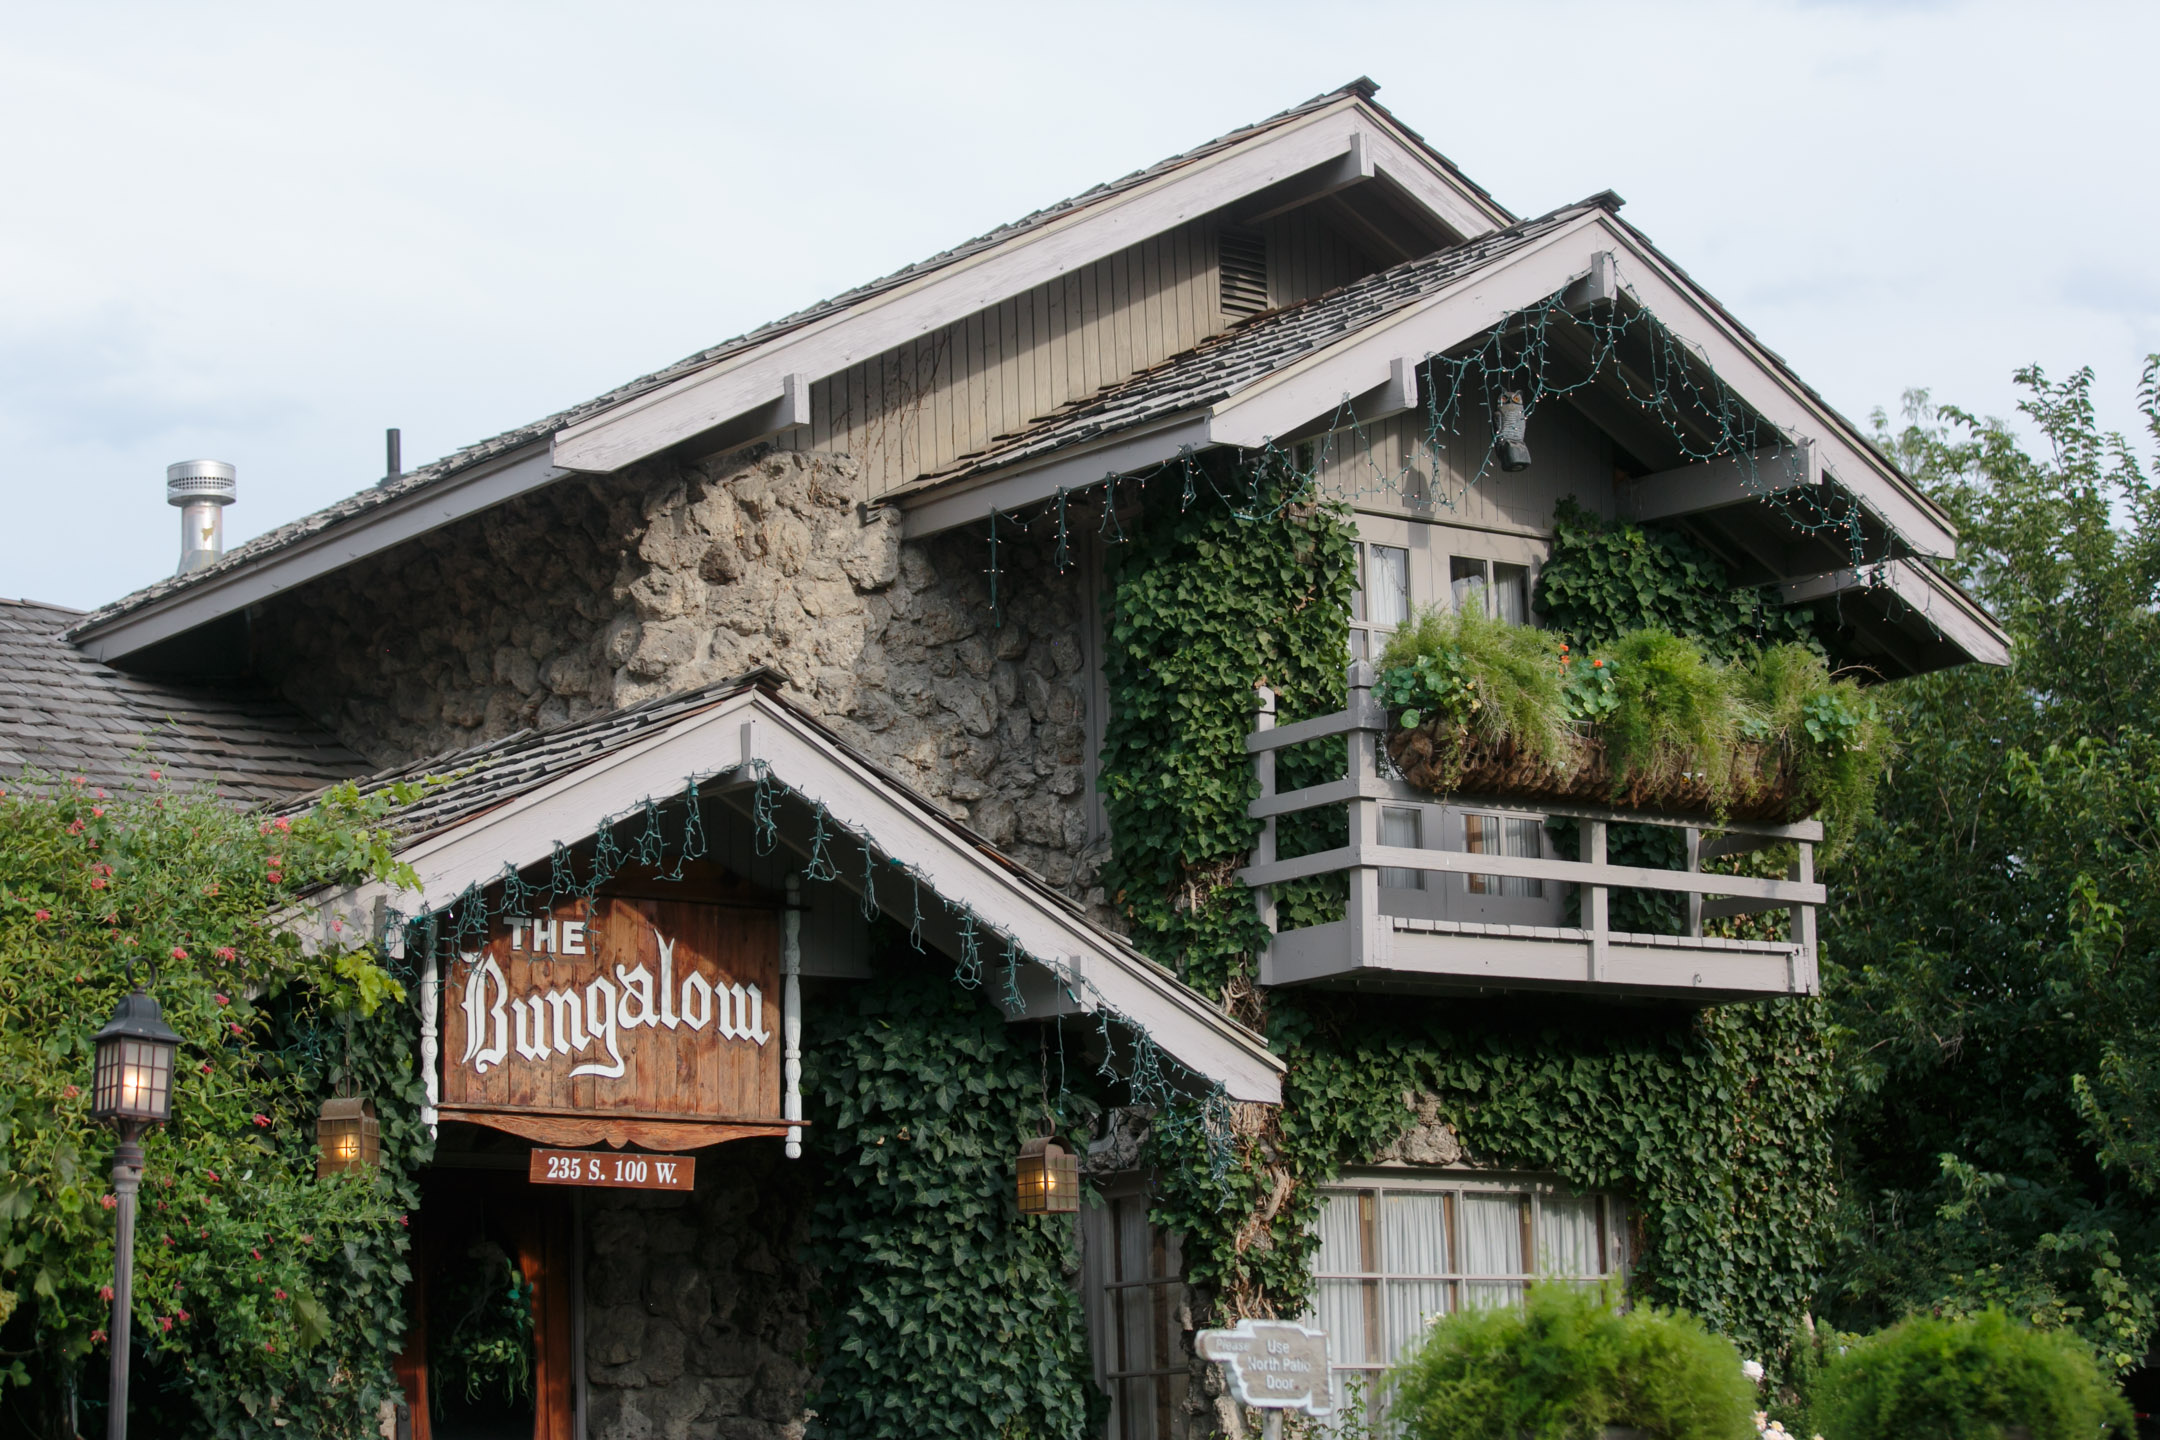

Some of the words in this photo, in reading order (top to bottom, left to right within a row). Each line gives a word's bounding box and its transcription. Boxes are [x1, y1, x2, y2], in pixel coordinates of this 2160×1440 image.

[503, 917, 586, 955] THE
[459, 928, 770, 1078] Bungalow
[547, 1156, 581, 1180] 235
[588, 1158, 606, 1181] S.
[614, 1160, 648, 1183] 100
[655, 1162, 678, 1184] W.
[1266, 1339, 1290, 1354] Use
[1247, 1356, 1280, 1371] North
[1283, 1358, 1312, 1372] Patio
[1266, 1374, 1295, 1390] Door
